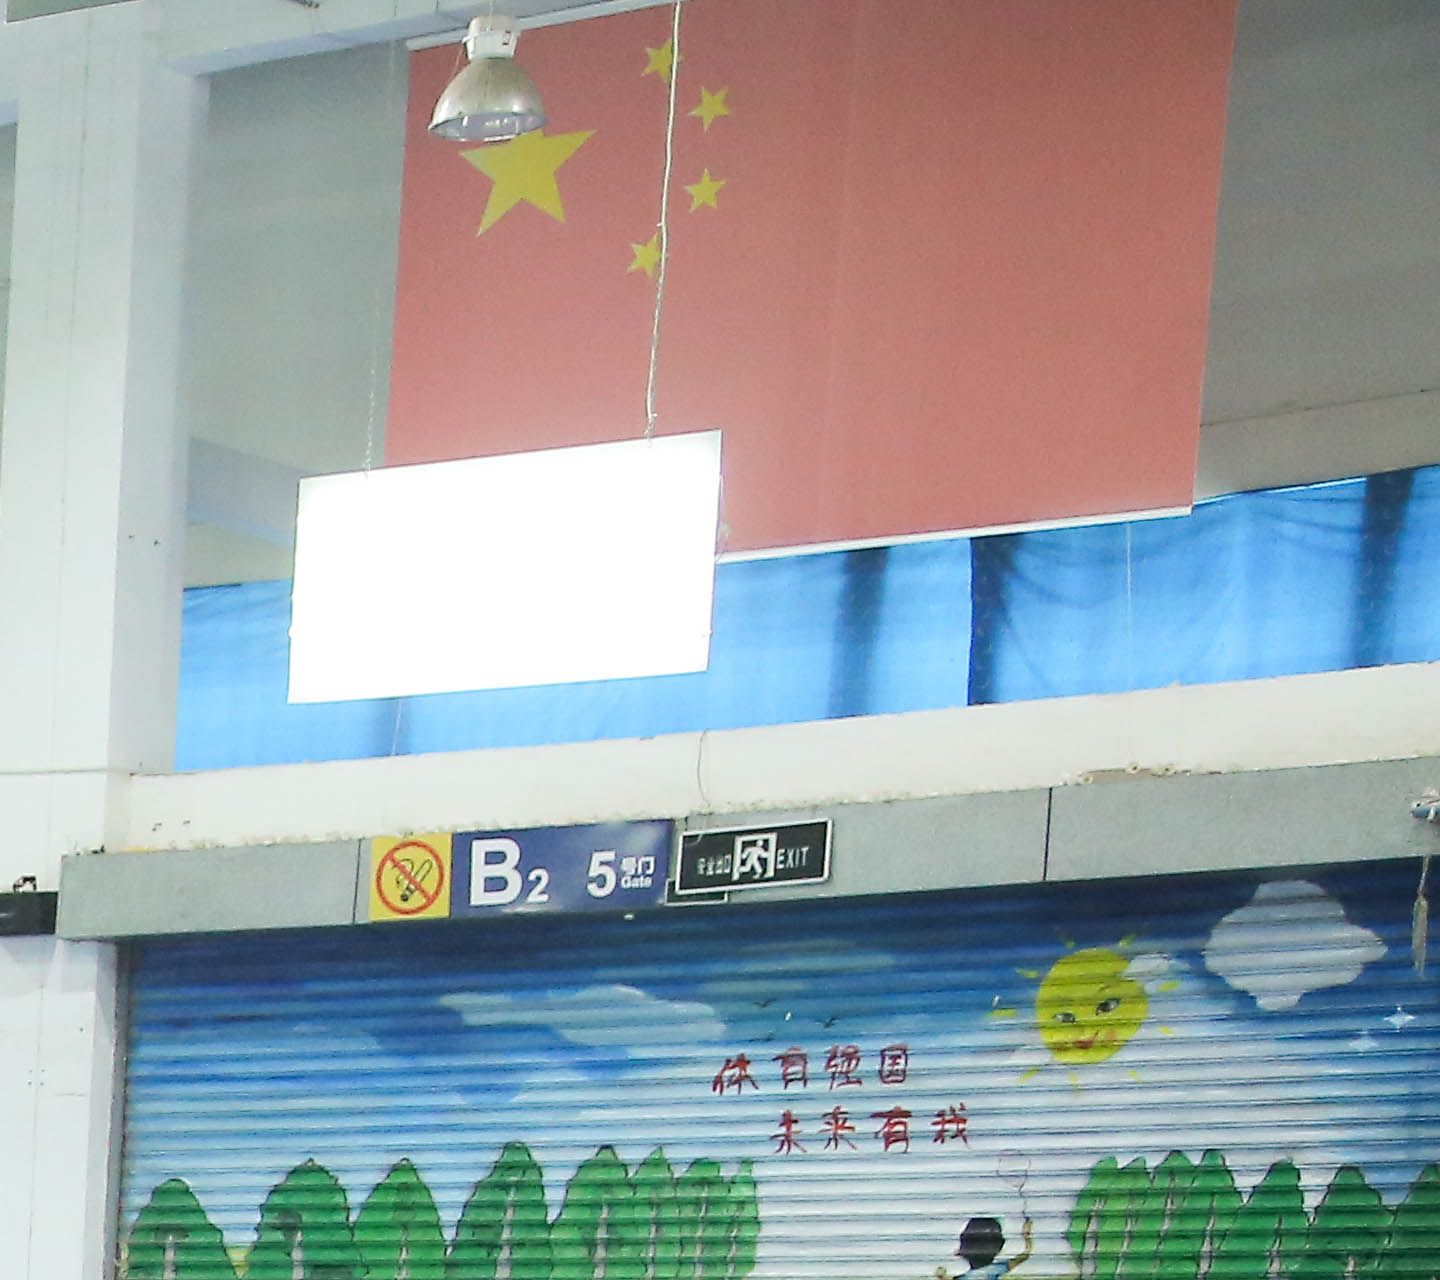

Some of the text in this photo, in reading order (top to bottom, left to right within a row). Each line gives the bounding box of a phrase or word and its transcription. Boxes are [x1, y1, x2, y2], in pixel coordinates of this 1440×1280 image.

[587, 850, 617, 898] 5
[777, 847, 809, 870] EXIT
[621, 874, 652, 889] Gate
[769, 1102, 970, 1155] 未来有我
